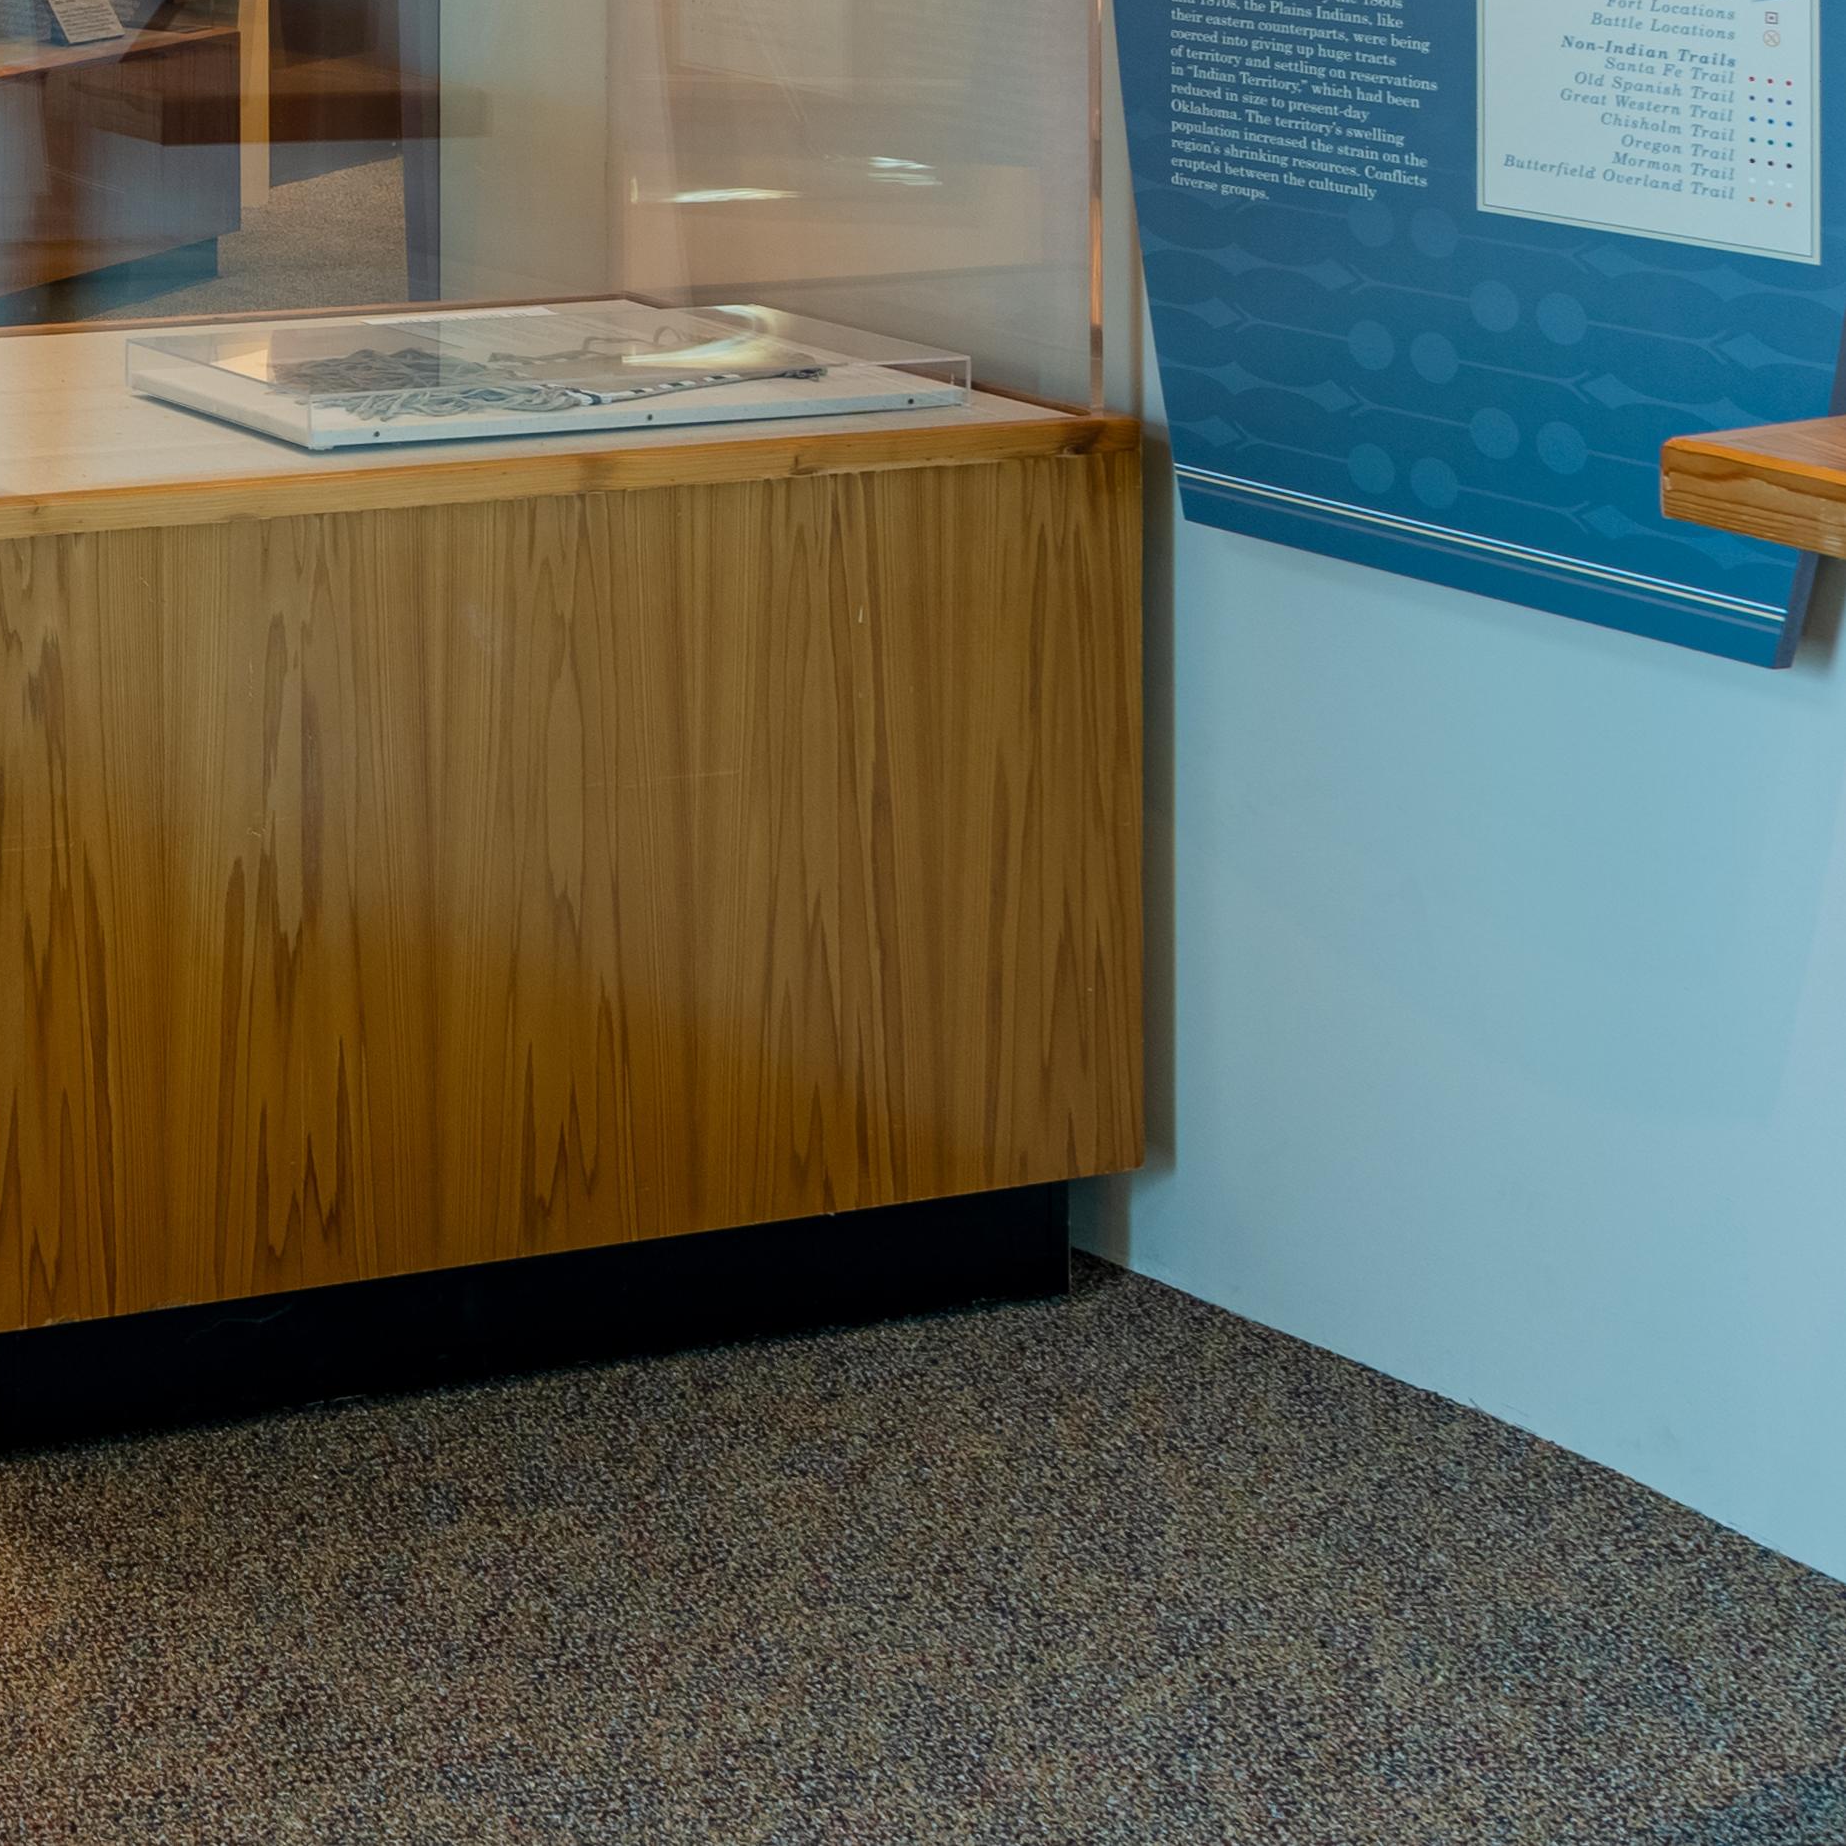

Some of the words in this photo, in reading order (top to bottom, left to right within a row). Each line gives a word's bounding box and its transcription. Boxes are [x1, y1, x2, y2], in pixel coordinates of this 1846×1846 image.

[1560, 34, 1668, 60] Non-Indian
[1677, 47, 1736, 68] Trails
[1620, 133, 1682, 155] Oregon
[1690, 142, 1735, 162] Trail
